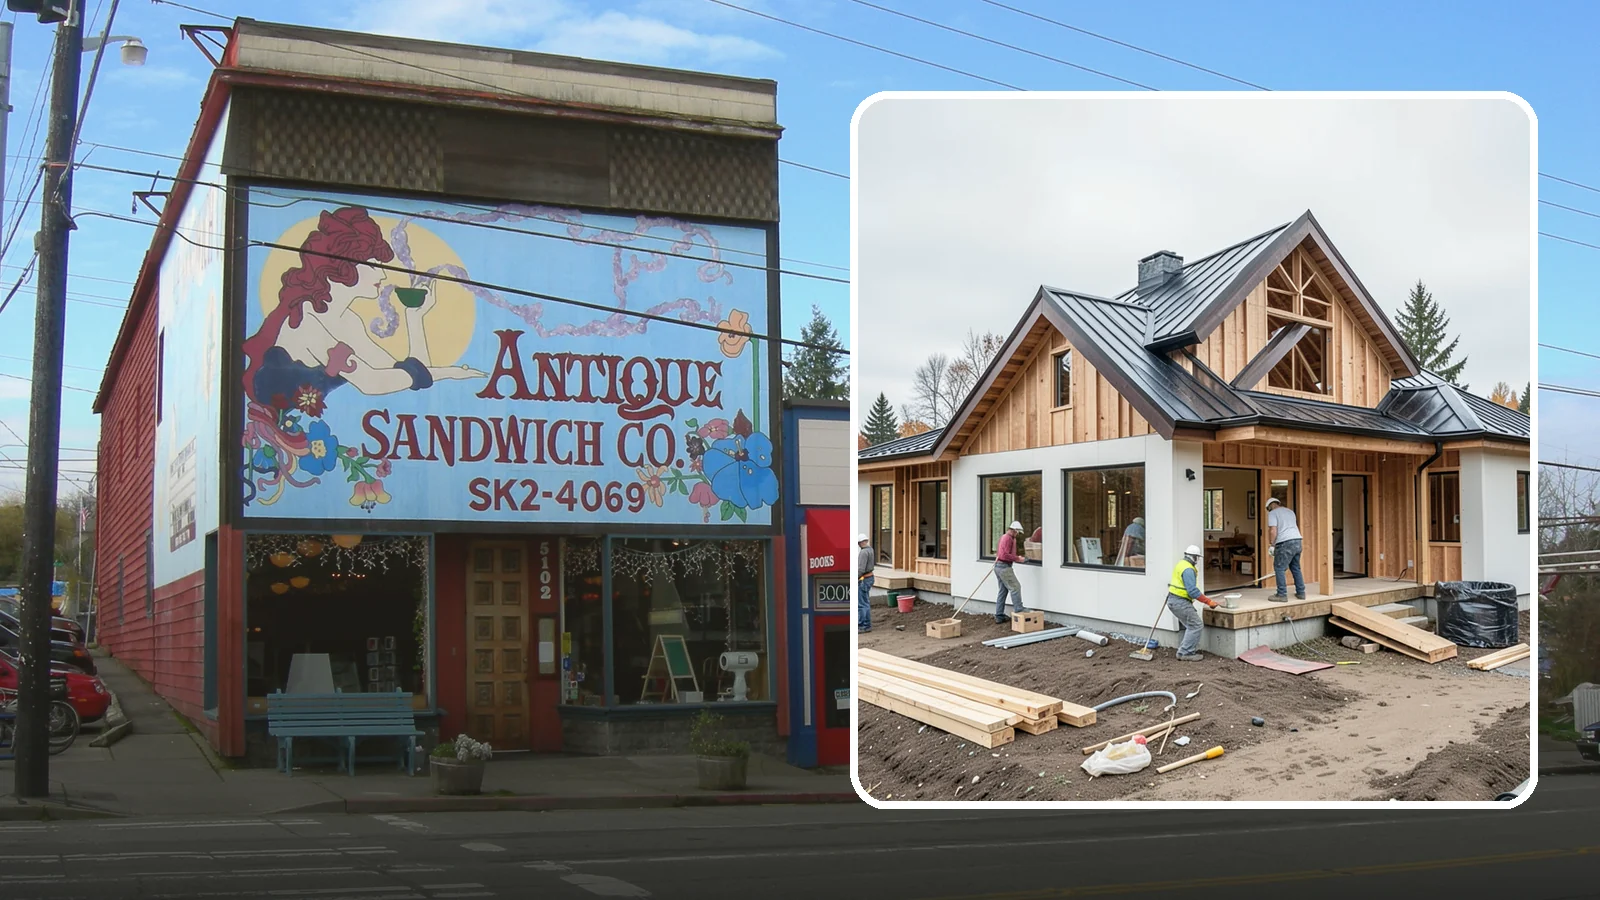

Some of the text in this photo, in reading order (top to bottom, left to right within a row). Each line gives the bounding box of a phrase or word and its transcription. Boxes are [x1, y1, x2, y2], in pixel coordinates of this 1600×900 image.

[475, 328, 724, 421] ANTIQUE
[361, 408, 685, 470] SANDWICH CO.
[467, 476, 646, 514] SK2-4069
[539, 541, 552, 600] 5102
[809, 554, 835, 569] BOOKS
